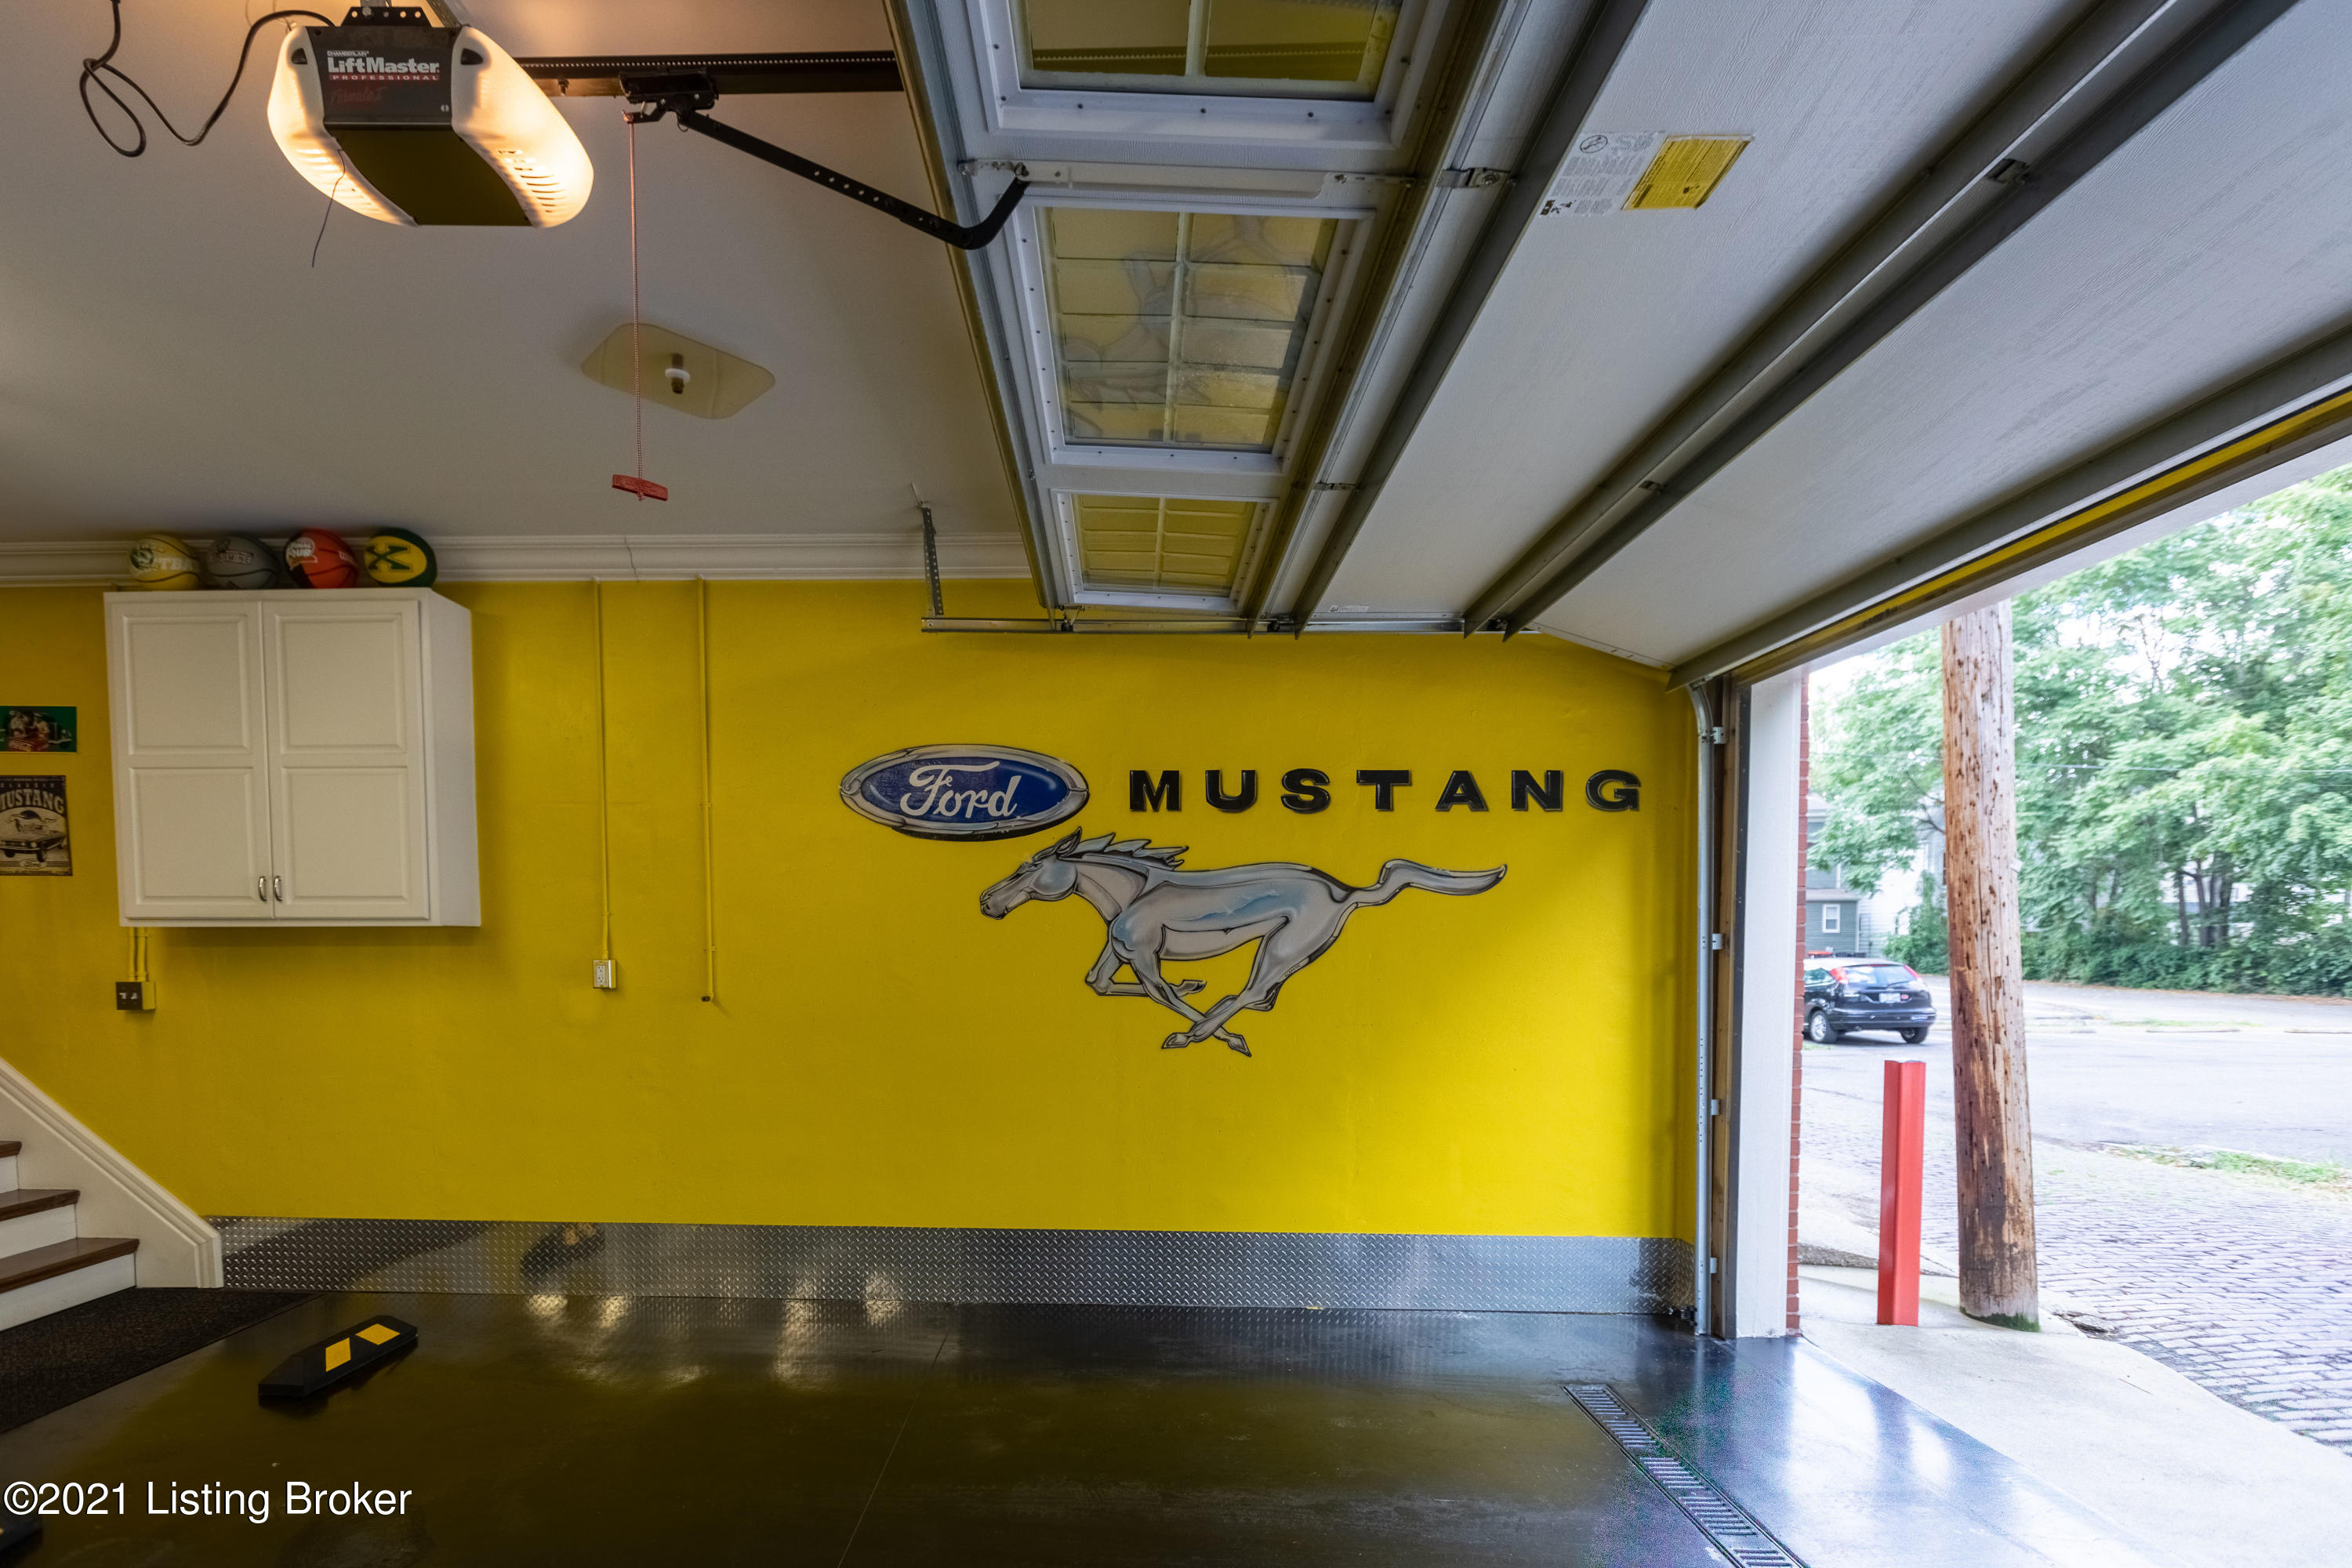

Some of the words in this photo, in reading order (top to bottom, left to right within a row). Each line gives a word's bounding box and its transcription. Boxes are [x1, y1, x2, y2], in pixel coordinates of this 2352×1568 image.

[327, 57, 440, 73] LiftMaster
[900, 760, 1022, 818] Ford
[1130, 769, 1641, 813] MUSTANG
